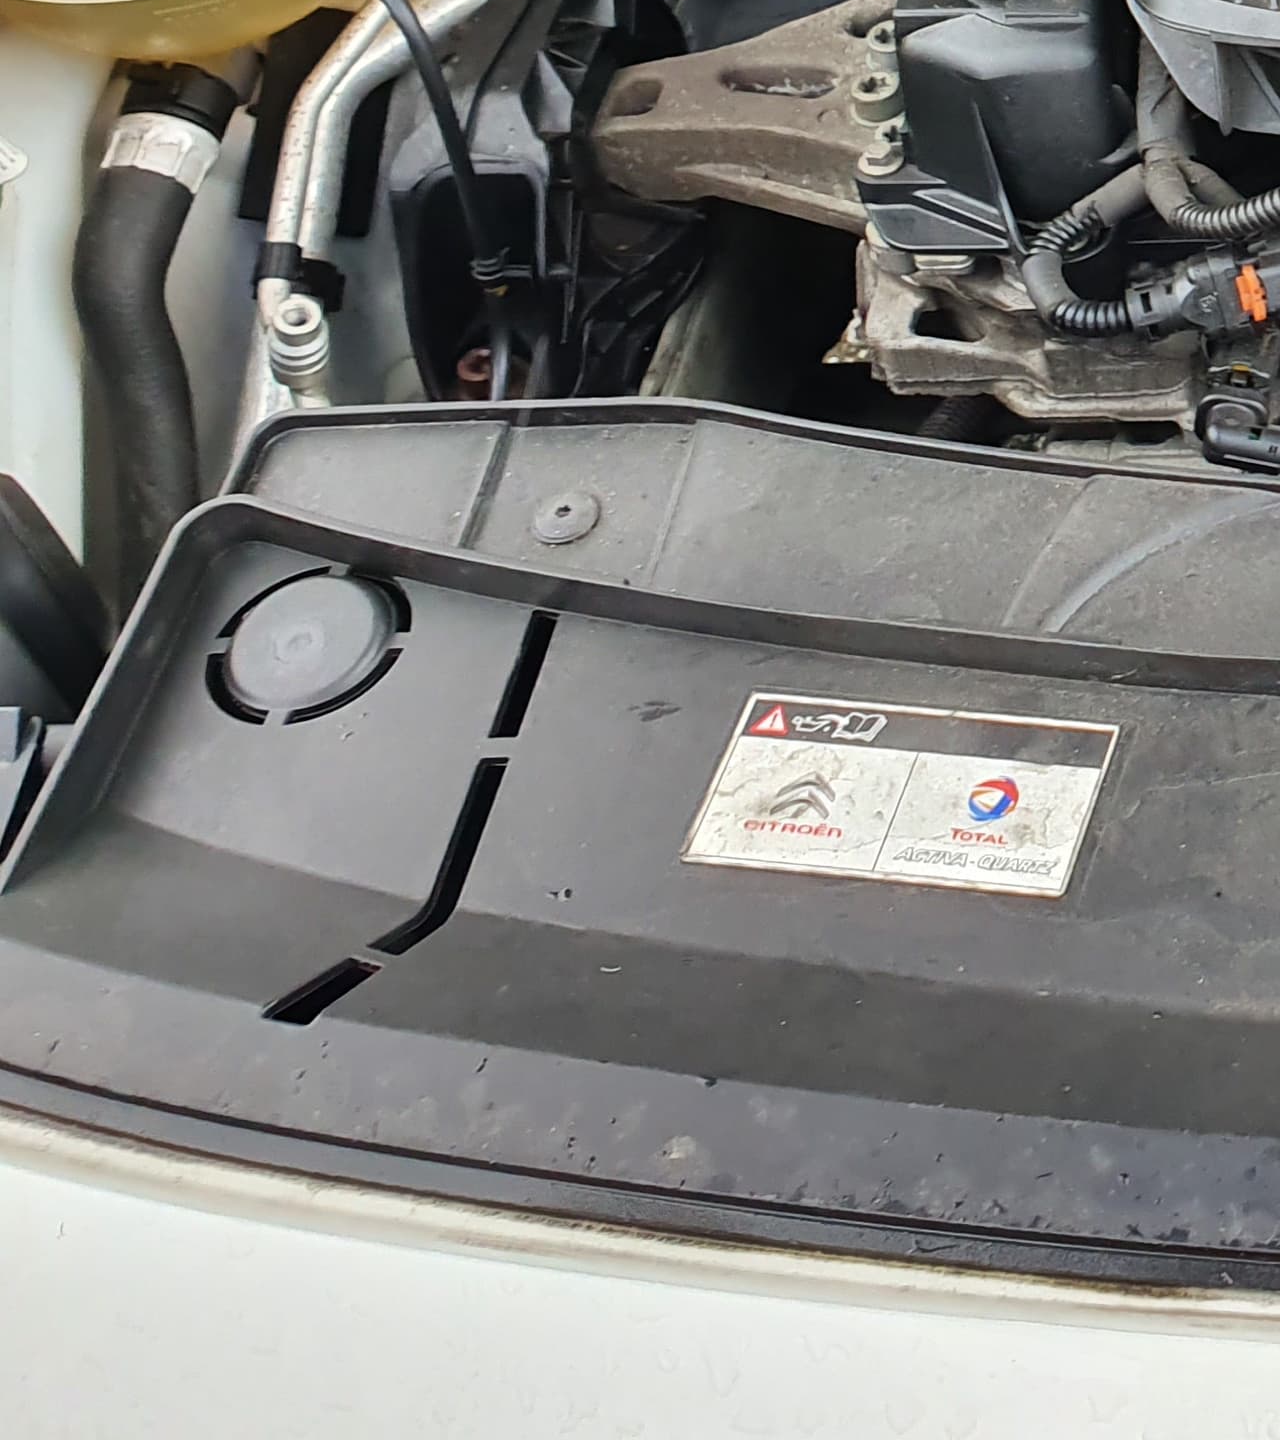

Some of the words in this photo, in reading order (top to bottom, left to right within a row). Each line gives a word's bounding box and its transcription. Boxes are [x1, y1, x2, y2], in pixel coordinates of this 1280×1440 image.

[742, 818, 844, 840] CITROËN
[949, 827, 1010, 847] TOTAL
[892, 846, 967, 869] ACTIVA
[976, 855, 1060, 876] QUARTZ
